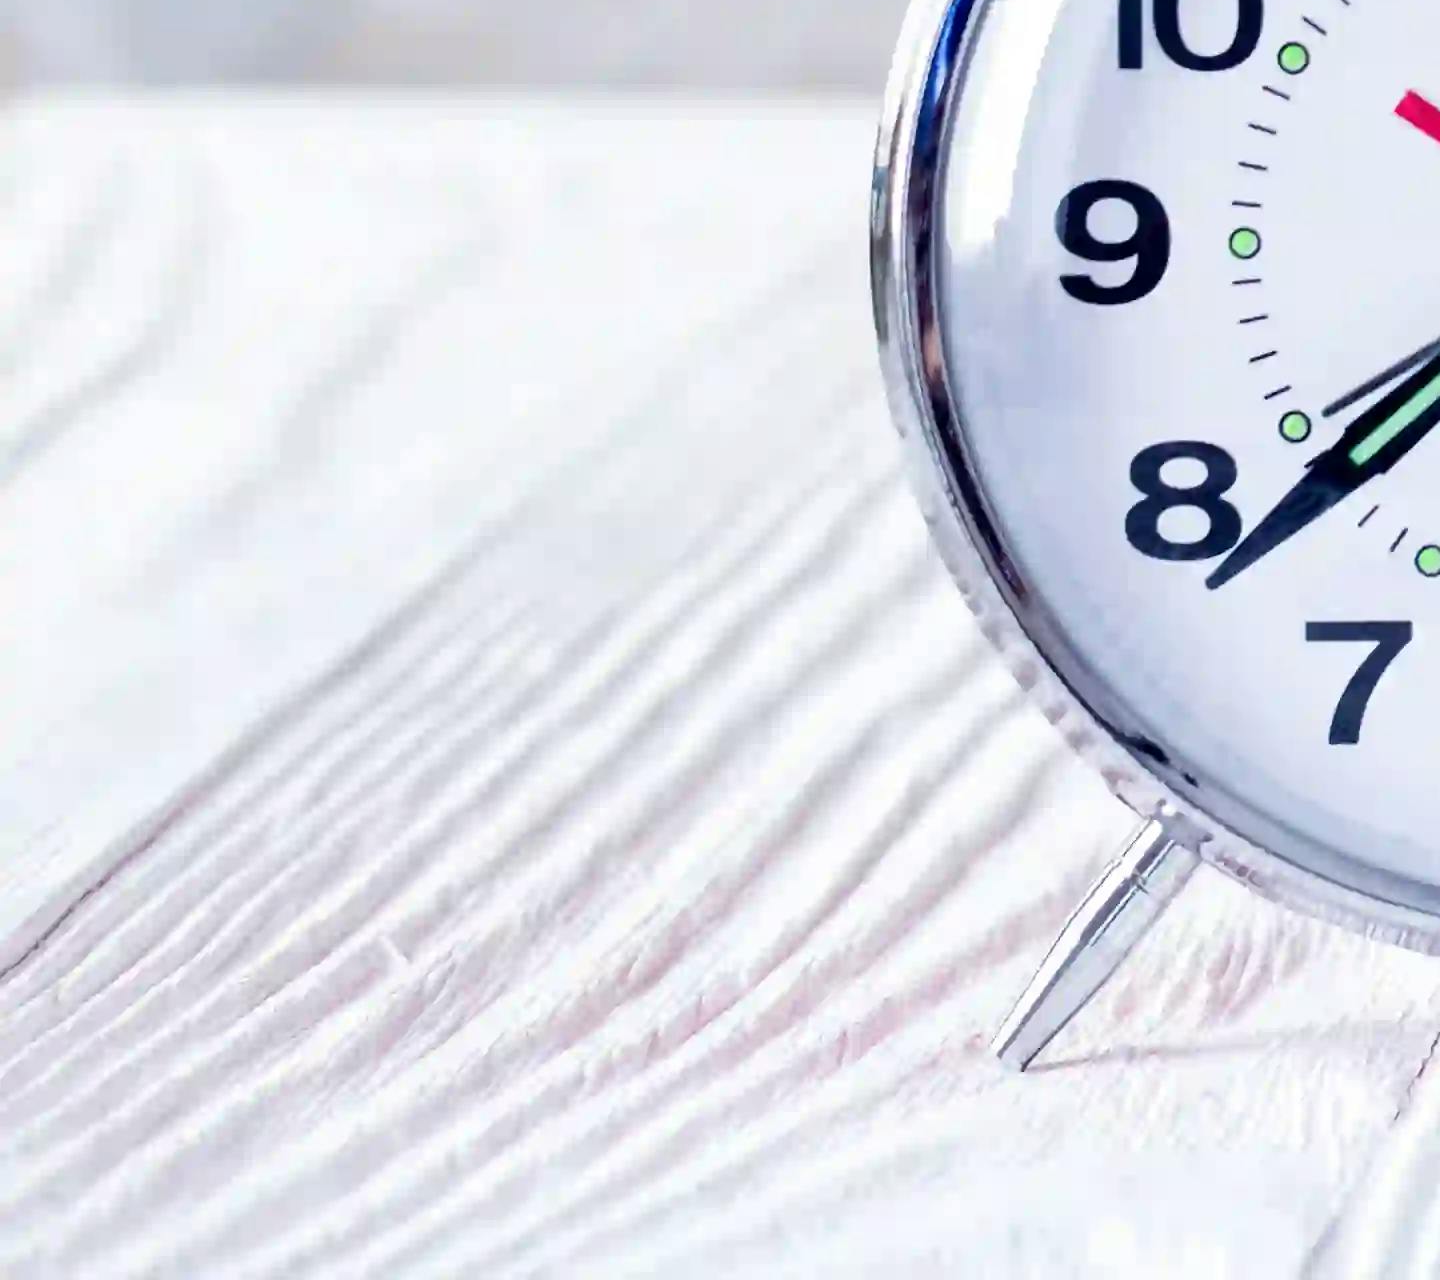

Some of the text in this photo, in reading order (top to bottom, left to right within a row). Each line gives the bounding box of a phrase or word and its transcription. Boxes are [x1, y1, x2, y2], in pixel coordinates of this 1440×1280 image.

[1054, 177, 1173, 307] 9
[1123, 439, 1244, 564] 8
[1303, 619, 1414, 747] 7
